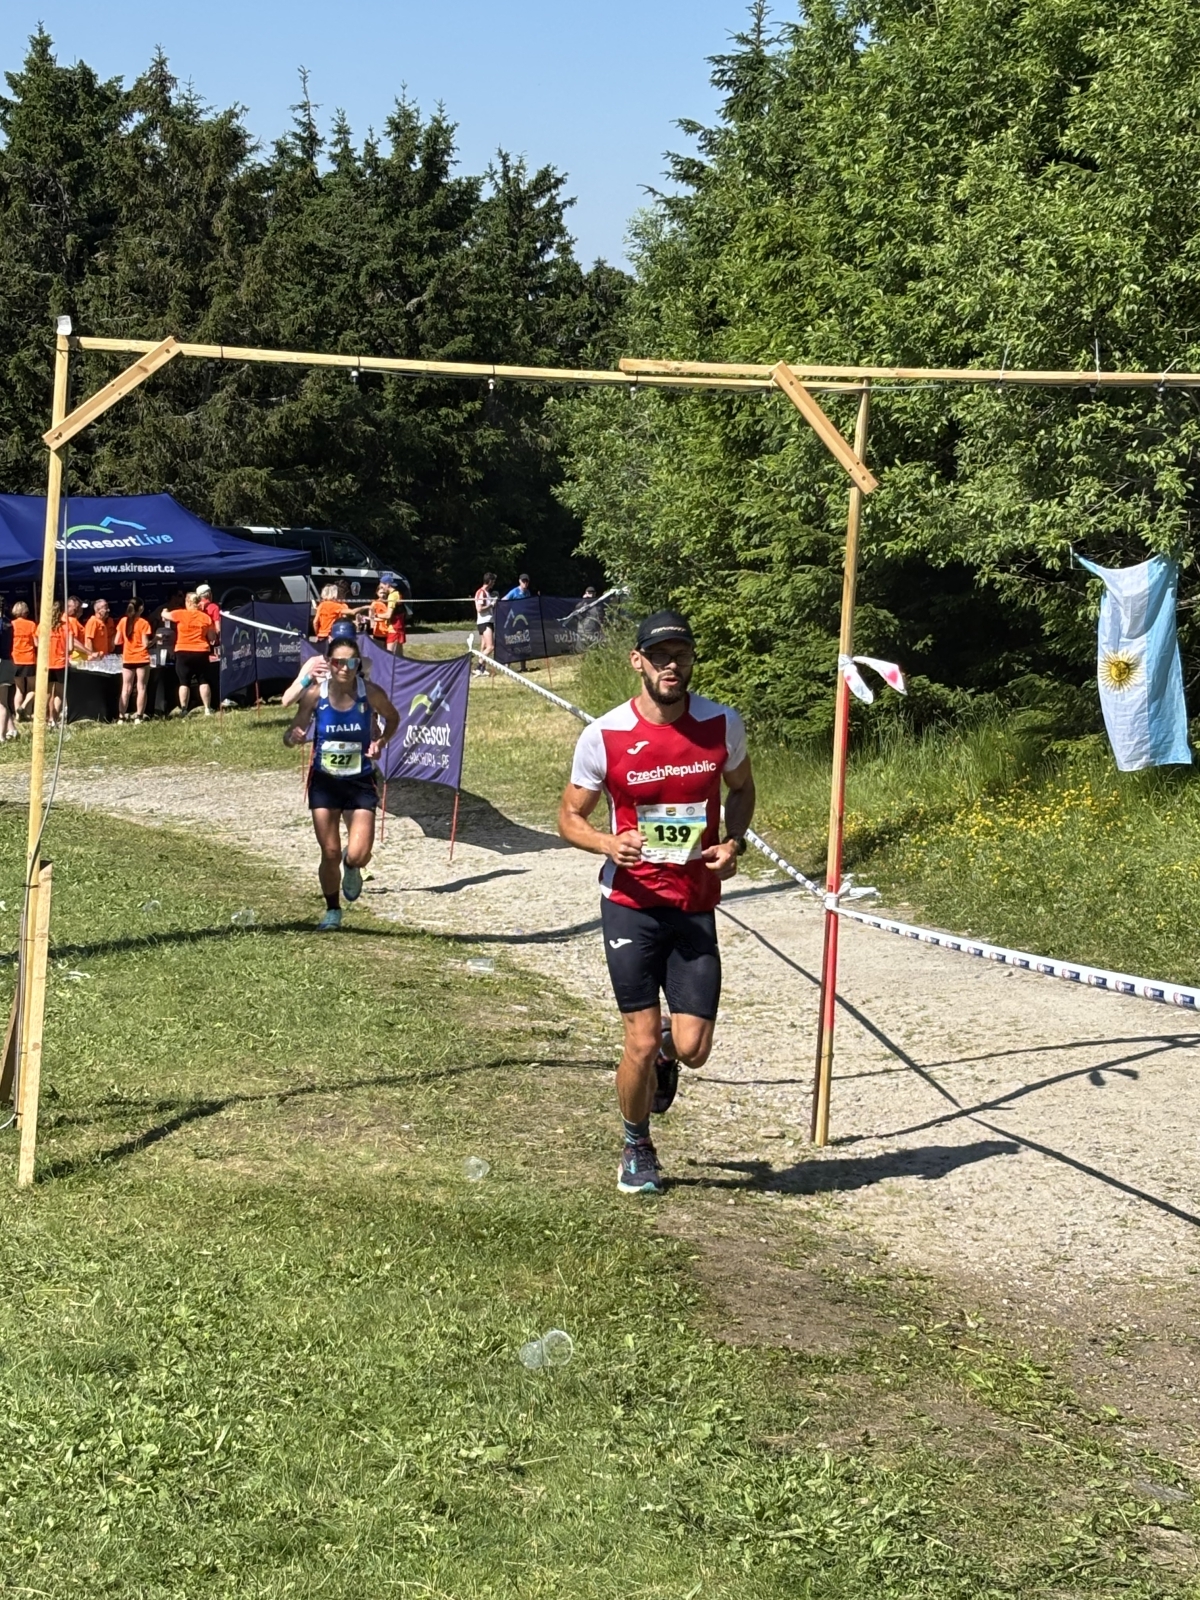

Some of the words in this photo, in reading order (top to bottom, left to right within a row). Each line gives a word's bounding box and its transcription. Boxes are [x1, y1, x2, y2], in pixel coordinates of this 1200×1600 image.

[55, 534, 174, 549] SkiResortLive
[93, 563, 175, 573] www.skiresort.cz
[326, 723, 361, 733] ITALIA
[330, 754, 352, 765] 227
[626, 760, 716, 783] CzechRepublic
[654, 825, 691, 842] 139
